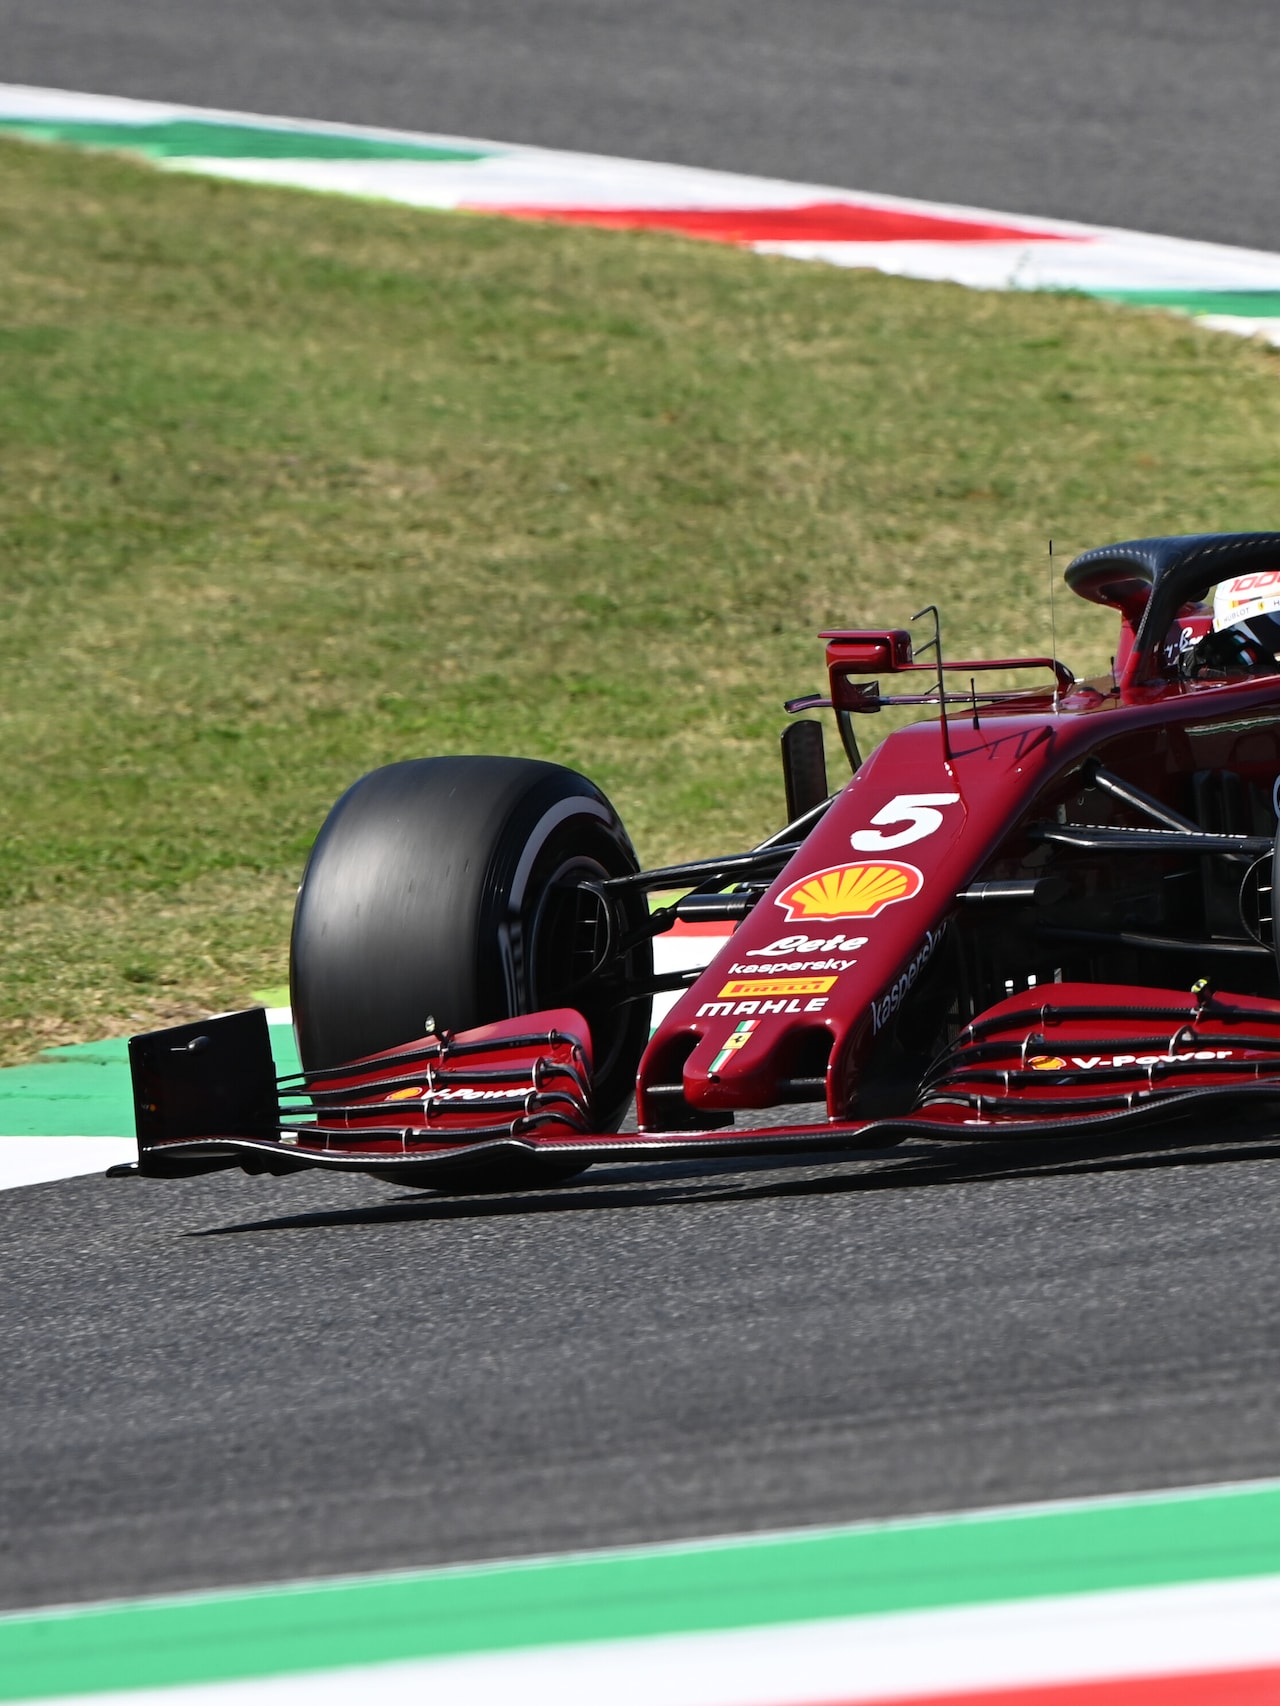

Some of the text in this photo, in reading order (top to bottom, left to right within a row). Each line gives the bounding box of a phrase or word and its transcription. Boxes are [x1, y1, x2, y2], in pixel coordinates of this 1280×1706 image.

[850, 792, 960, 852] 5
[728, 958, 857, 975] kaspersky
[730, 980, 826, 994] PIRELLI
[695, 997, 829, 1017] MAHLE
[1072, 1051, 1233, 1069] V-Power
[421, 1087, 537, 1100] V-Power
